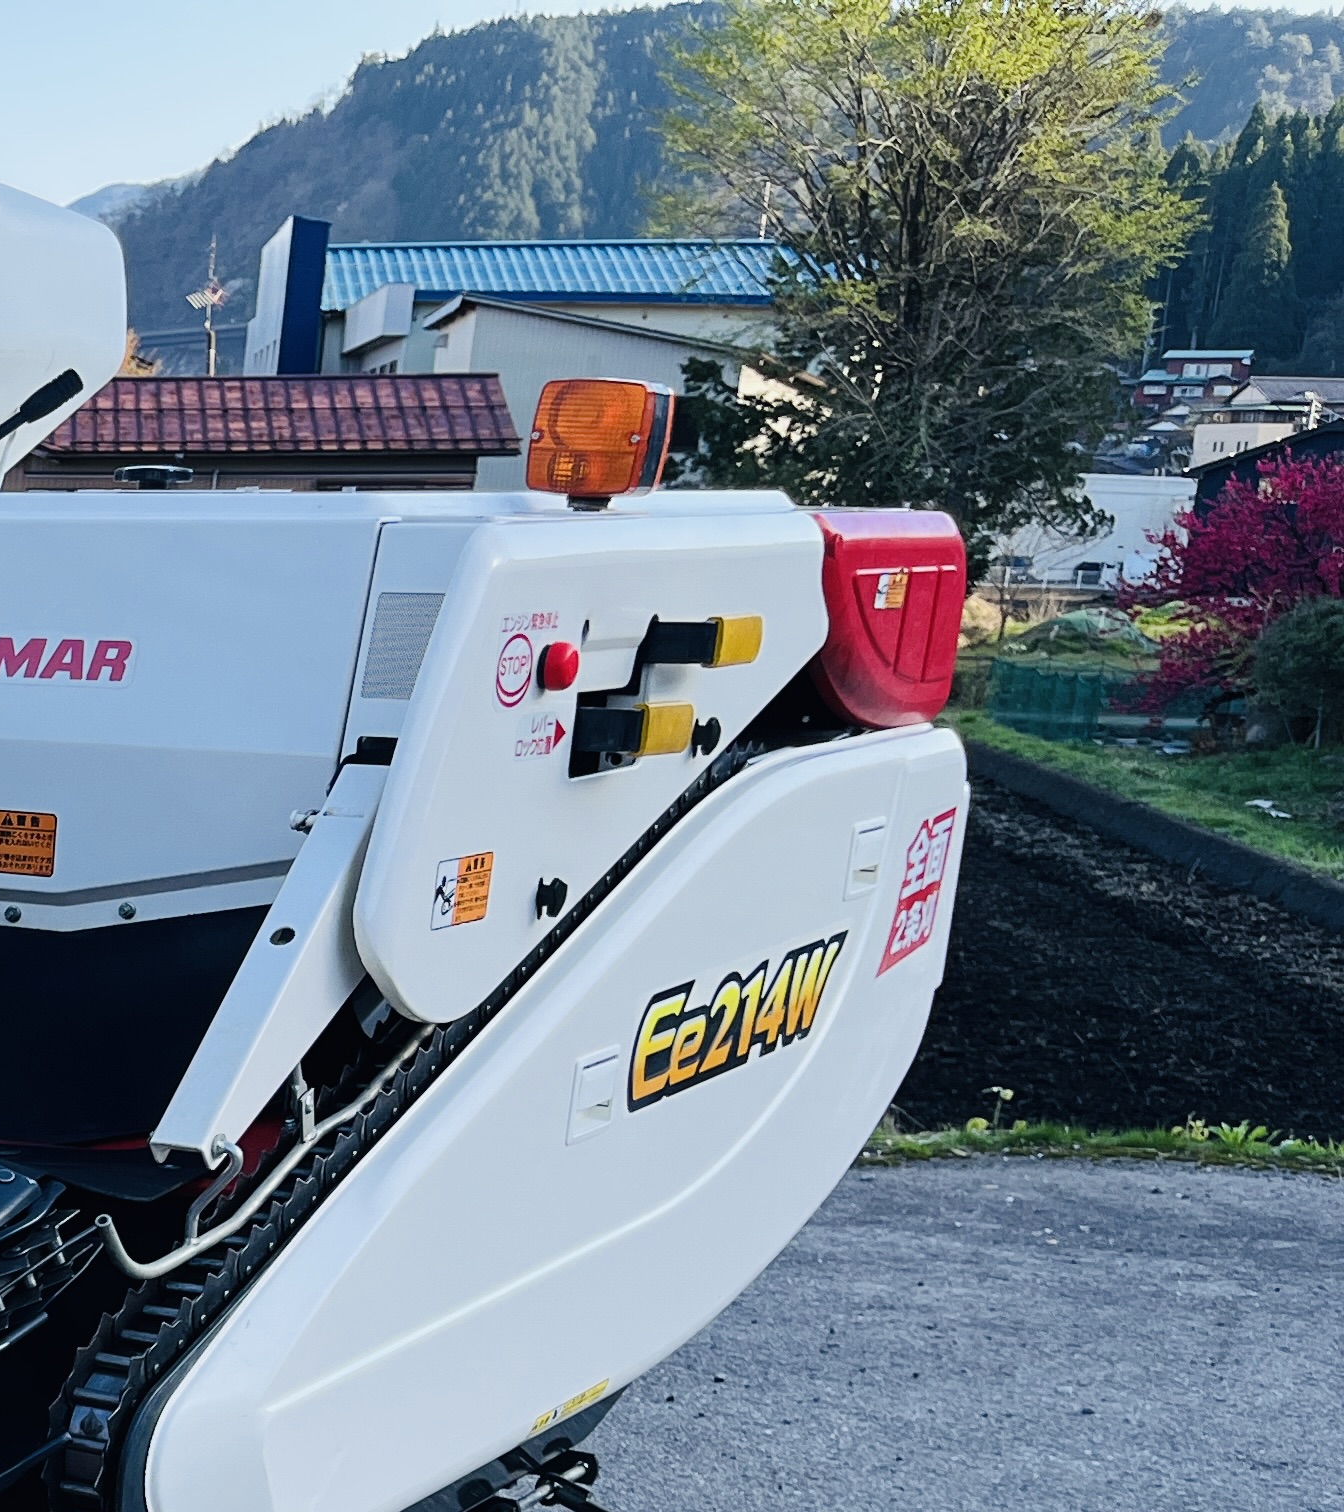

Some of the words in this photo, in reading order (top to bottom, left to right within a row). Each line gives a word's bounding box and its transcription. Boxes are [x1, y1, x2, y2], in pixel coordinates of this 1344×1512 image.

[501, 610, 560, 633] エンジン緊急停止
[499, 654, 531, 677] STOP!
[530, 715, 554, 734] レバー
[514, 735, 552, 757] ロック位置
[900, 817, 953, 900] 全面
[631, 937, 843, 1105] Ee214W
